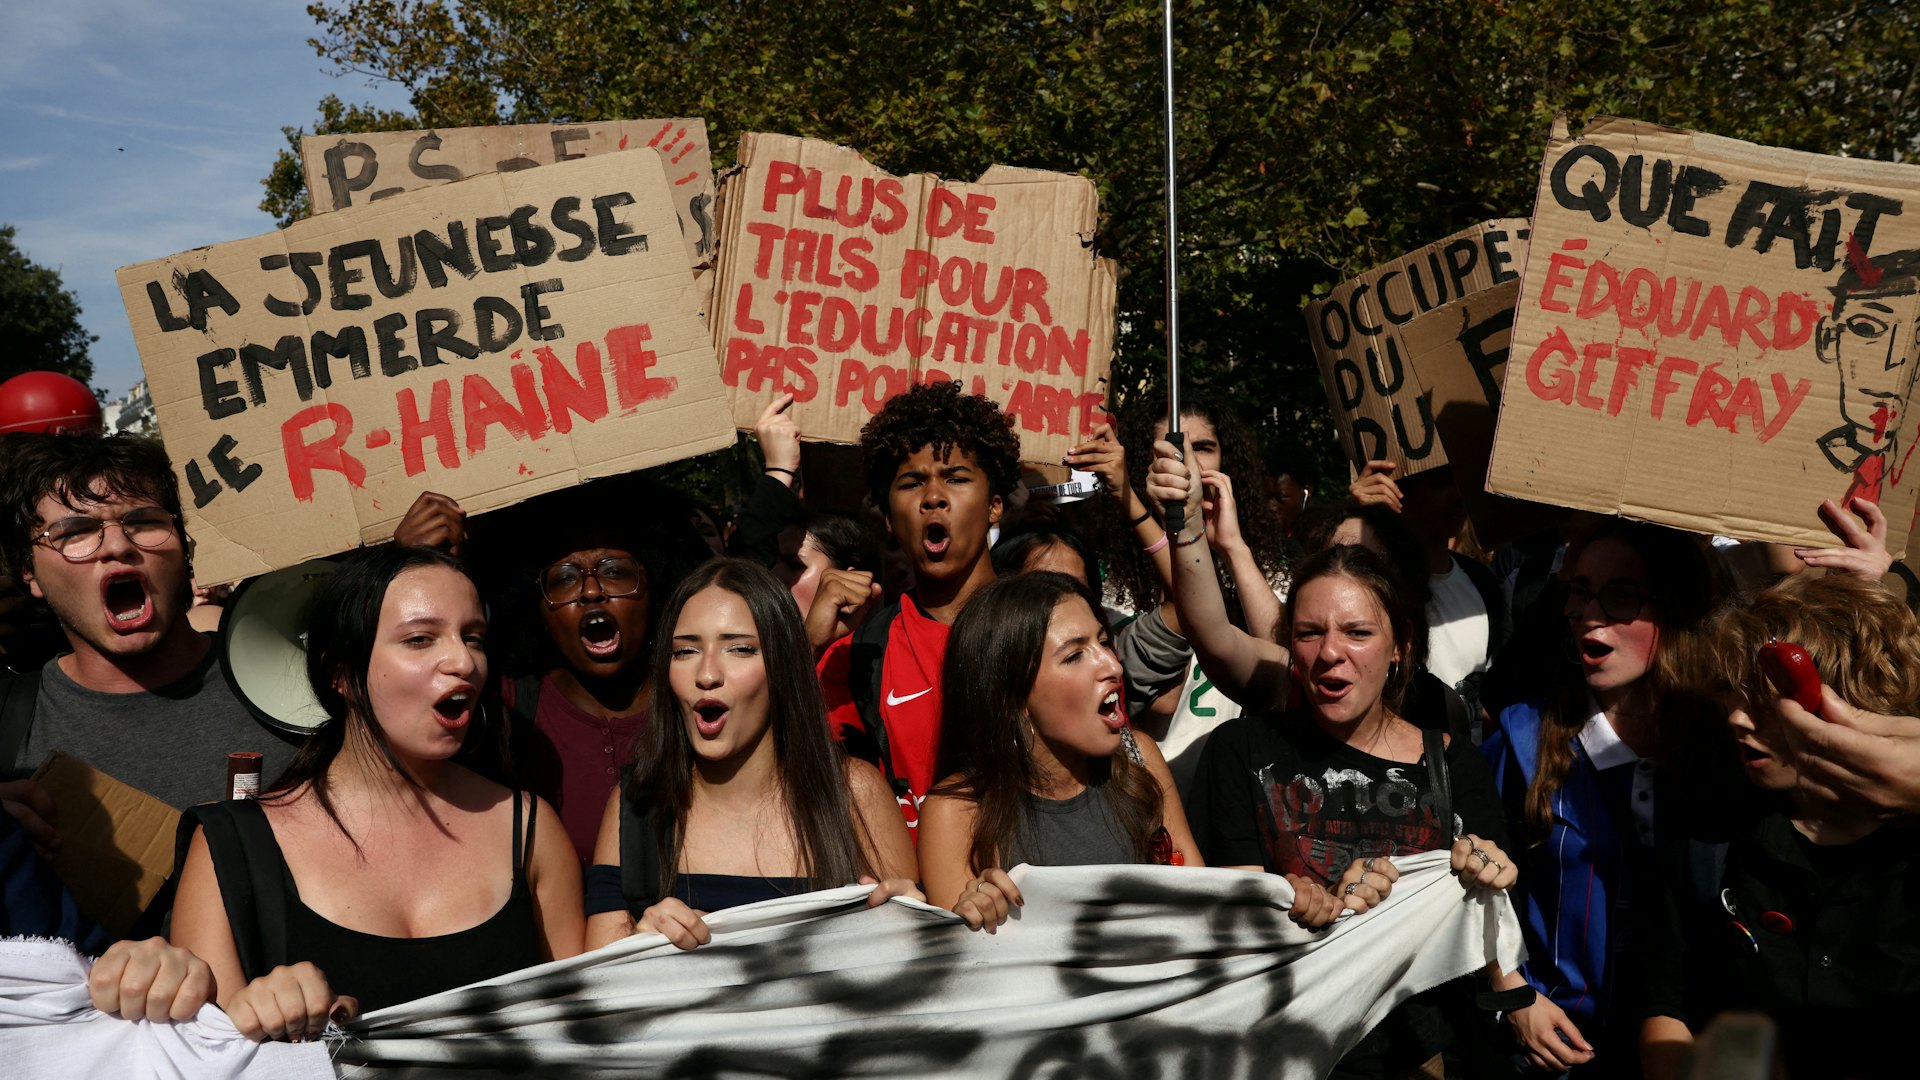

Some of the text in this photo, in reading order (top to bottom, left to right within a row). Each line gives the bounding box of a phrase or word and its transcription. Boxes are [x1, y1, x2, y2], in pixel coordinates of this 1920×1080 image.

[762, 160, 908, 235] PLUS
[925, 187, 997, 244] DE
[1550, 144, 1903, 273] QUE FAIT
[147, 267, 240, 332] LA
[260, 192, 649, 317] JEUNESSE
[746, 221, 880, 293] TALS
[900, 248, 1053, 326] POUR
[1540, 238, 1819, 351] ÉDOUARD
[197, 278, 566, 420] EMMERDE
[722, 337, 819, 403] PAS
[834, 358, 953, 415] PO
[735, 282, 1092, 377] L'EDUCATION
[1333, 335, 1405, 412] DU
[1351, 387, 1435, 468] DU
[1525, 326, 1812, 444] GEFFRAY
[184, 434, 264, 510] LE
[1189, 659, 1217, 717] 2
